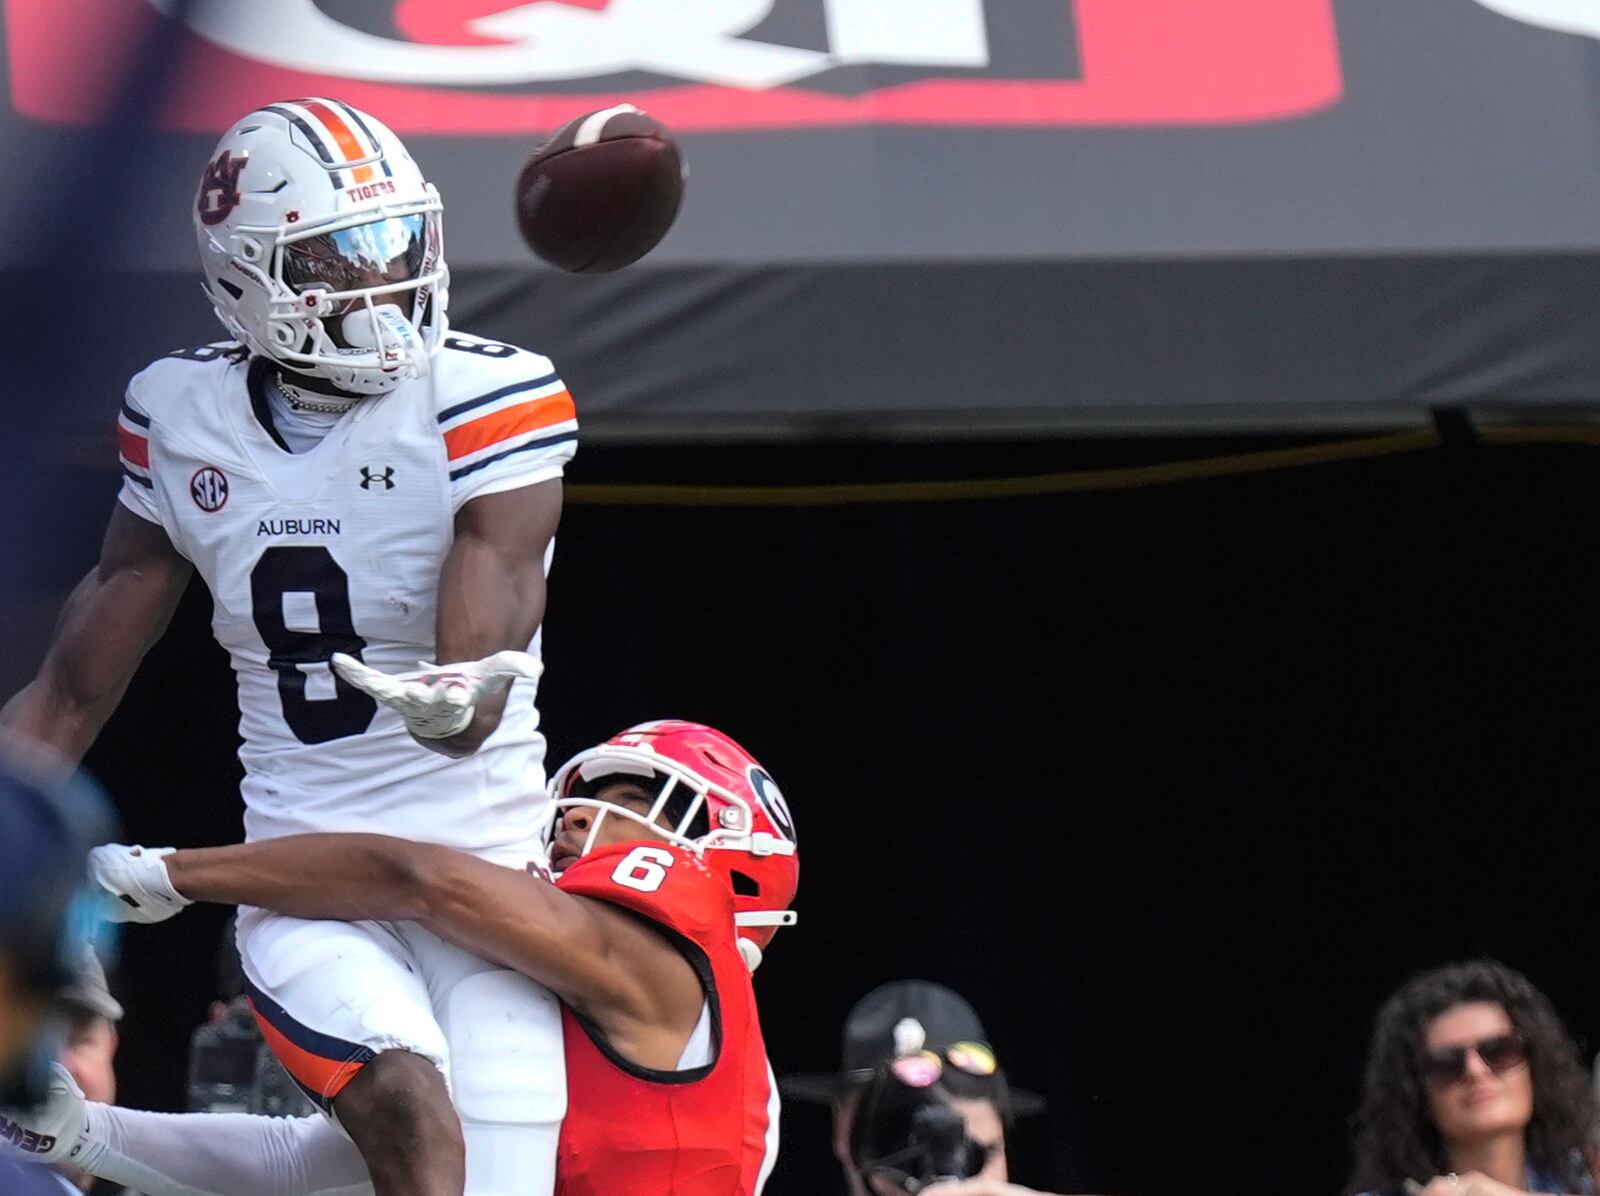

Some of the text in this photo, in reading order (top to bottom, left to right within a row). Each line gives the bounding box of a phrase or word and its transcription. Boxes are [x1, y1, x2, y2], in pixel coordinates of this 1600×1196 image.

[346, 181, 396, 203] TIGERS
[193, 469, 226, 502] SEC
[256, 519, 342, 536] AUBURN
[250, 546, 378, 744] 8
[610, 846, 674, 892] 6
